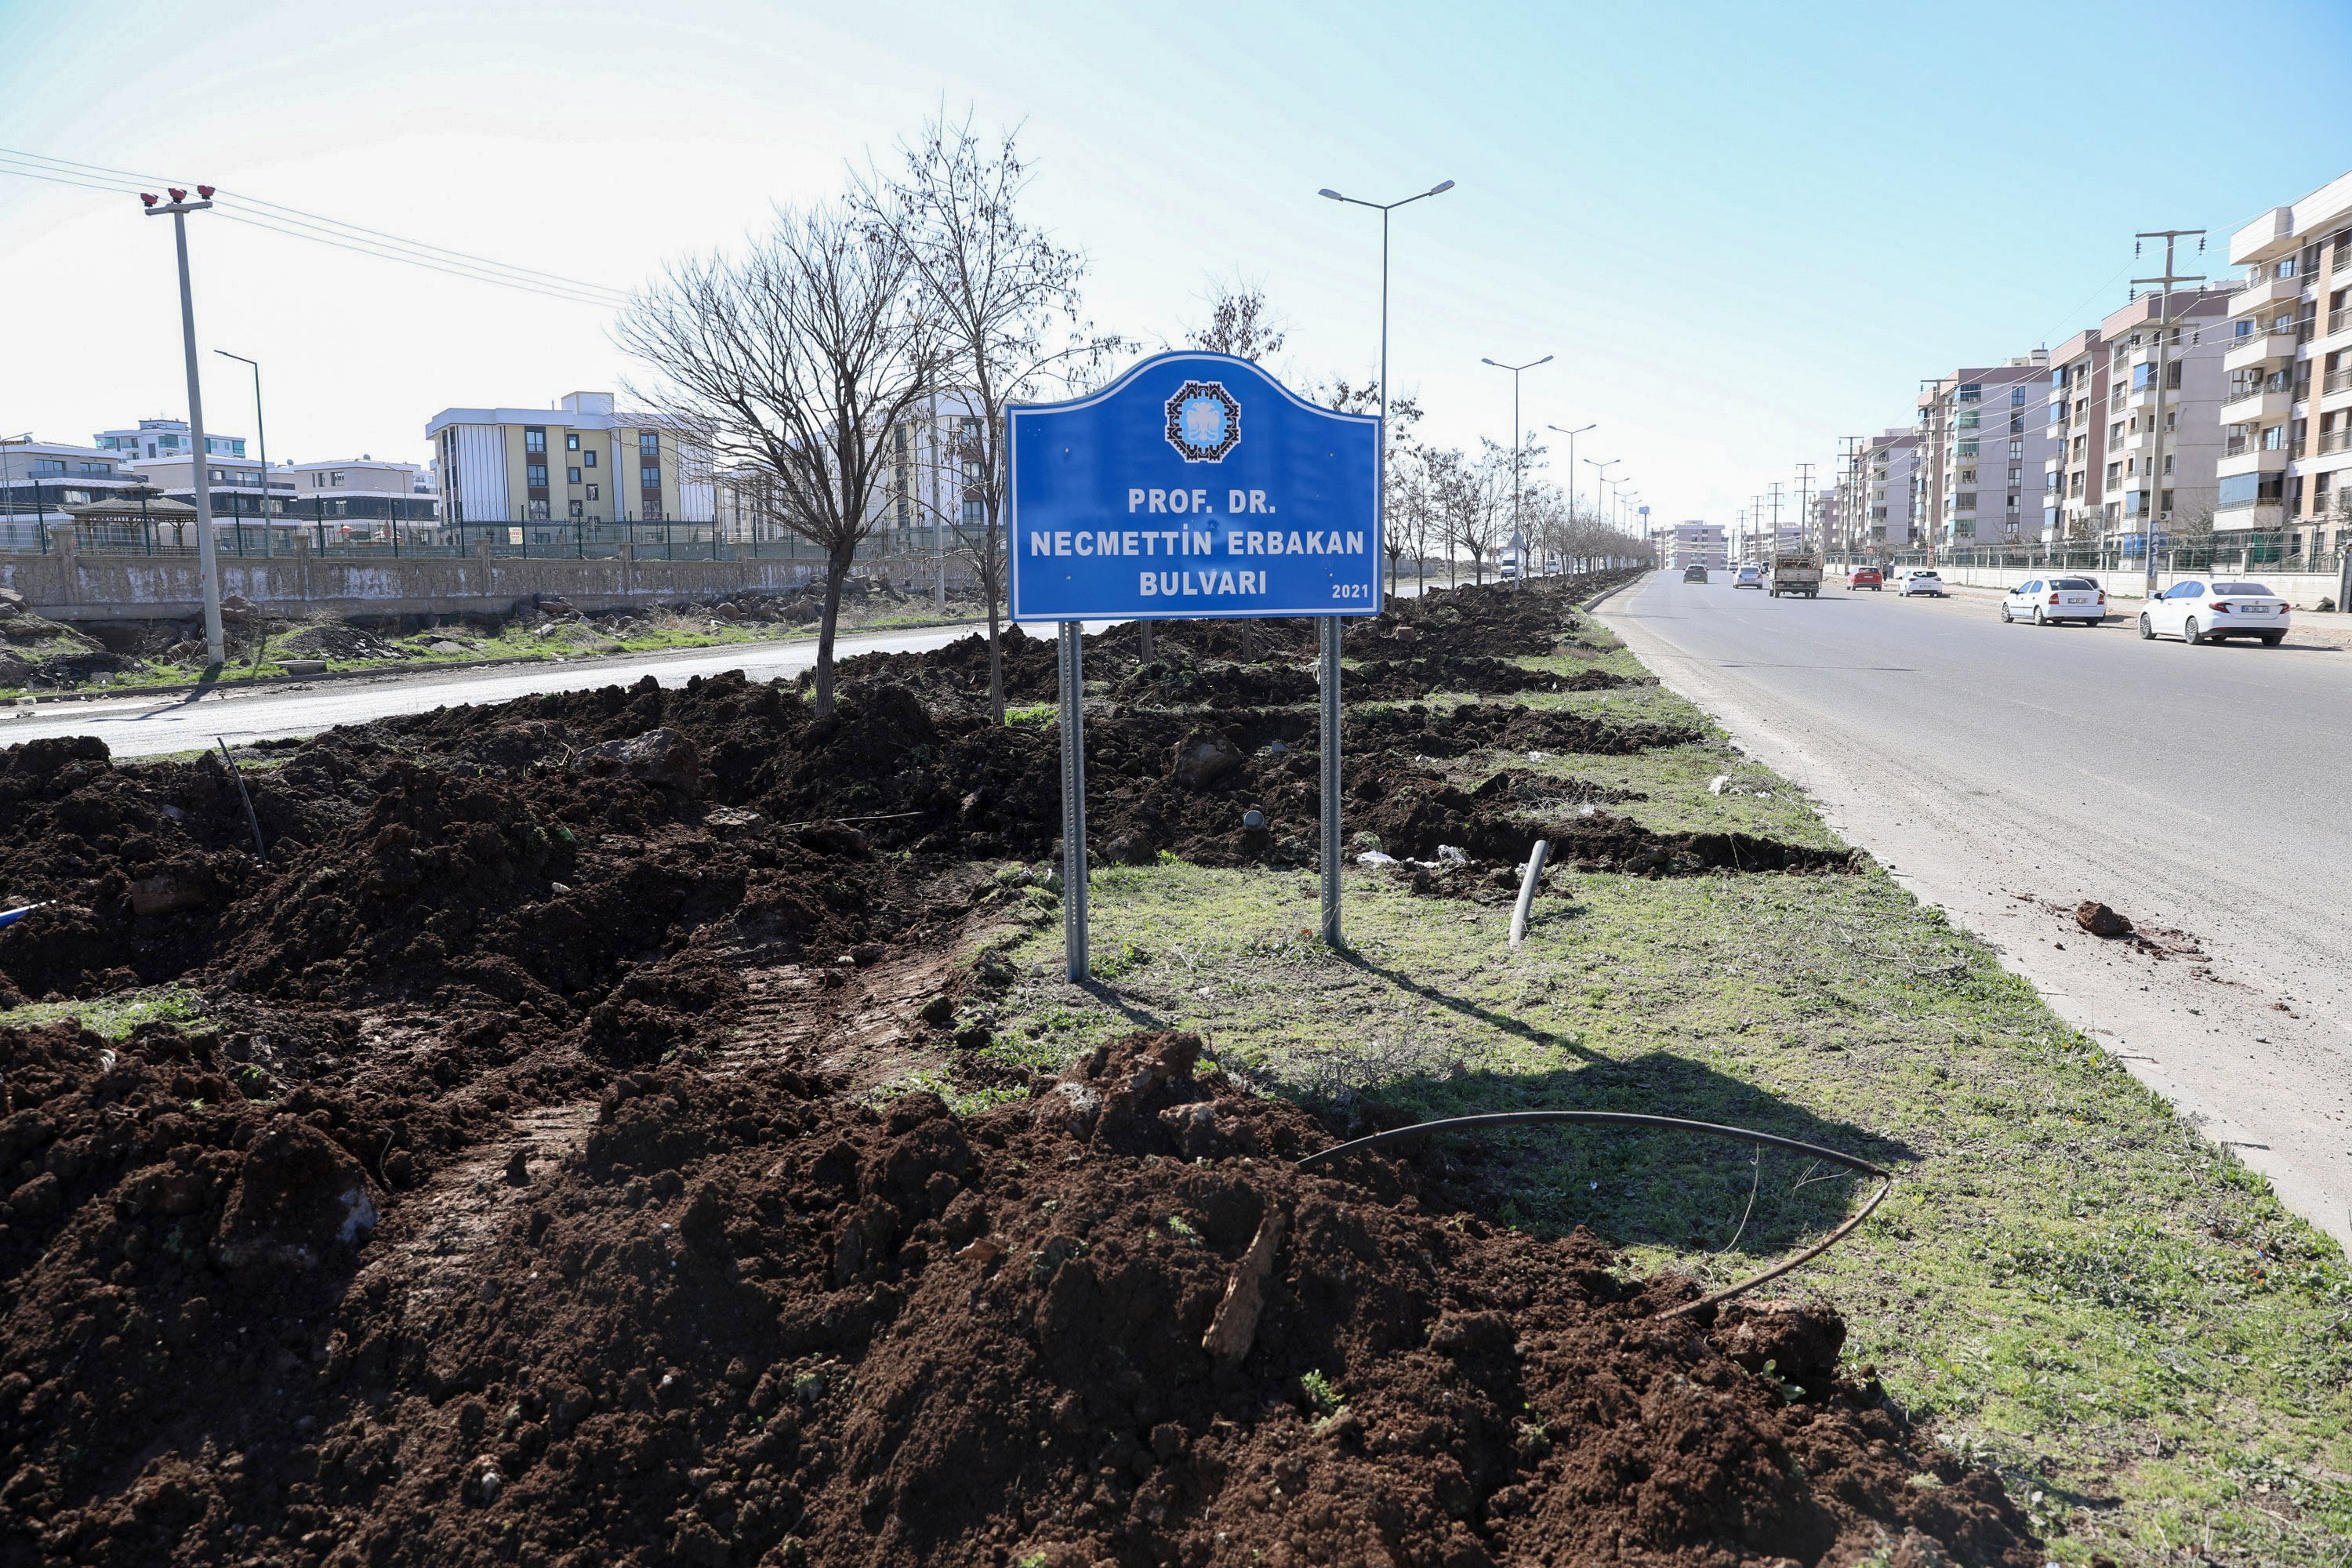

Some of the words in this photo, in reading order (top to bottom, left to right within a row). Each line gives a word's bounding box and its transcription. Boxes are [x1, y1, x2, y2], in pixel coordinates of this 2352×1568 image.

[1128, 488, 1213, 514] PROF.
[1229, 489, 1276, 514] DR.
[1030, 523, 1212, 557] NECMETTİN
[1228, 531, 1363, 555] ERBAKAN
[1139, 570, 1266, 597] BULVARI
[1332, 584, 1369, 599] 2021
